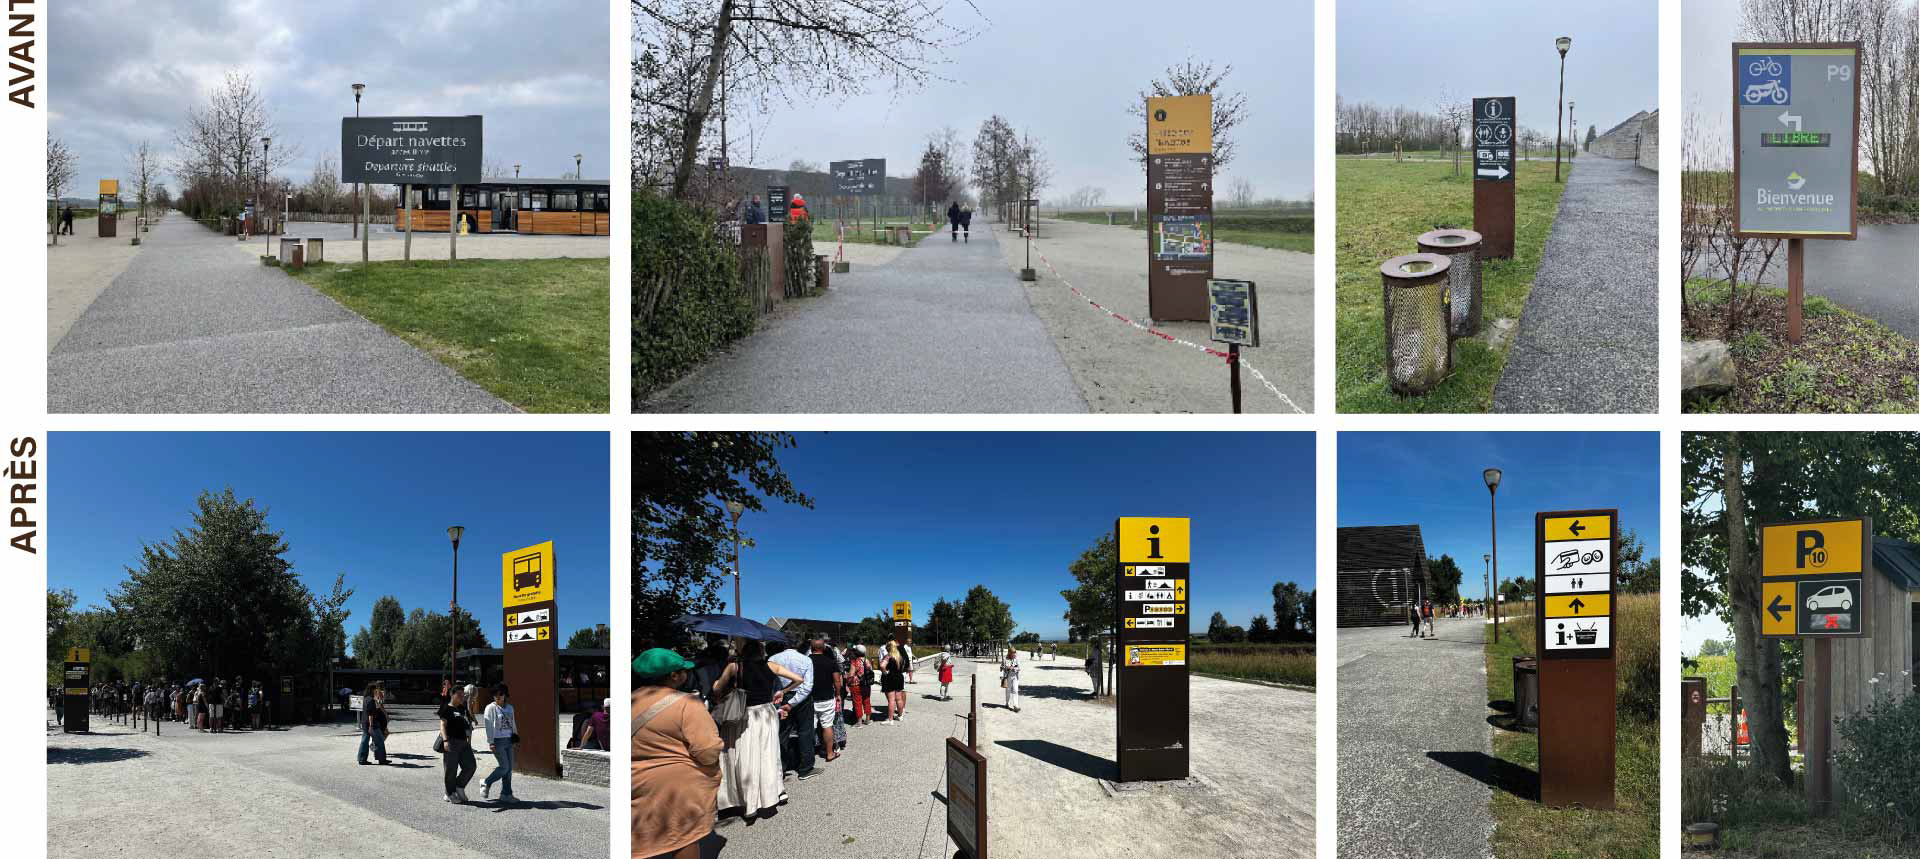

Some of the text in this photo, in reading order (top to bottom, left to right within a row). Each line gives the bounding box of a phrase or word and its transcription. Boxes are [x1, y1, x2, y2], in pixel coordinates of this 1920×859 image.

[1827, 64, 1851, 82] P9
[357, 134, 467, 150] Départ navettes
[1772, 131, 1820, 144] LIBRE
[417, 161, 457, 172] shuttles
[1757, 187, 1834, 206] Bienvenue
[1796, 529, 1825, 569] P
